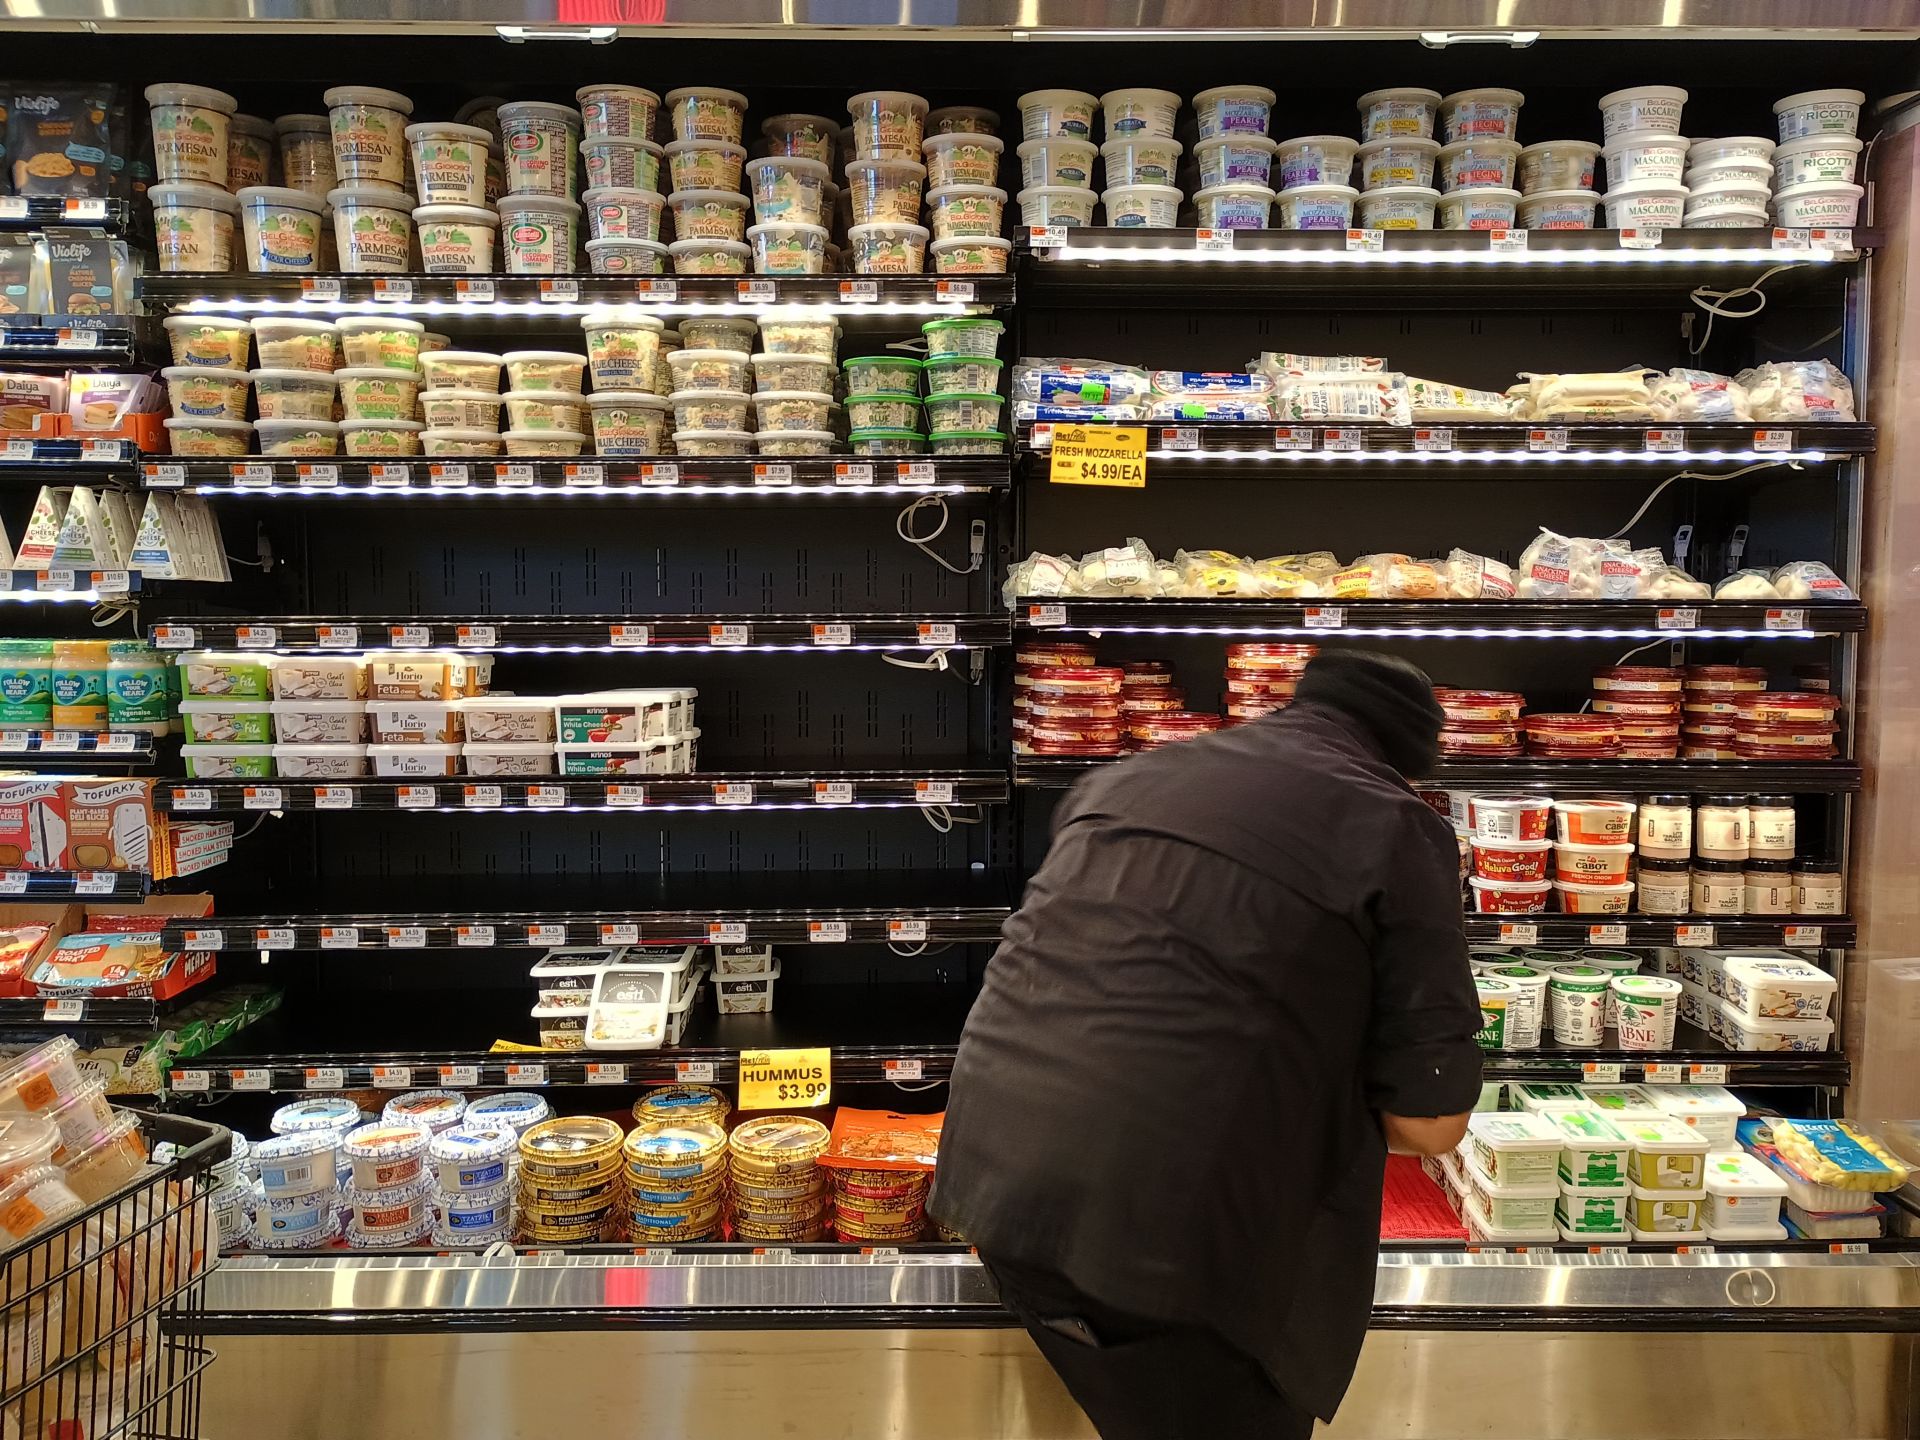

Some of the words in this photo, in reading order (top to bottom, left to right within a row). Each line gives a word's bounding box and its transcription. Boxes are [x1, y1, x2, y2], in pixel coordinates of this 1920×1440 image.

[1806, 110, 1855, 120] RICOTTA
[1230, 116, 1260, 127] PEARLS
[865, 134, 911, 145] PARMESAN
[157, 143, 217, 158] PARMESAN
[336, 142, 392, 156] PARMESAN
[1804, 157, 1853, 167] RICOTTA
[1236, 166, 1264, 176] PEARLS
[420, 172, 475, 186] PARMESAN
[677, 176, 714, 186] PARMESAN
[1227, 216, 1257, 224] PEARLS
[1309, 216, 1338, 225] PEARLS
[689, 226, 735, 236] PARMESAN
[52, 244, 91, 262] Violife
[350, 241, 409, 256] PARMESAN
[424, 254, 476, 266] PARMESAN
[864, 264, 908, 273] PARMESAN
[391, 282, 405, 290] $7.99
[654, 283, 671, 291] $6.99
[607, 359, 642, 368] CHEESE
[7, 379, 39, 392] Daiya
[92, 378, 121, 389] Daiya
[357, 402, 399, 412] ROMANO
[869, 414, 890, 423] BLUE
[615, 438, 649, 447] CHEESE
[1055, 446, 1084, 457] FRESH
[1086, 448, 1143, 460] MOZZARELLA
[249, 467, 264, 475] $4.99
[1081, 462, 1142, 480] $4.99/EA
[1539, 572, 1564, 581] CHEESE
[407, 628, 421, 636] $4.29
[624, 627, 640, 635] $6.99
[829, 626, 843, 634] $6.99
[396, 672, 423, 681] Horio
[3, 679, 30, 687] FOLLOW
[56, 680, 80, 688] FOLLOW
[119, 679, 150, 687] FOLLOW
[377, 684, 399, 694] Feta
[400, 719, 426, 728] Horio
[382, 732, 403, 741] Feta
[400, 763, 426, 771] Horio
[0, 783, 49, 798] TOFURKY
[82, 783, 136, 800] TOFURKY
[414, 788, 429, 796] $4.29
[480, 787, 495, 796] $4.29
[544, 787, 559, 796] $4.79
[182, 832, 203, 844] SMOKED
[205, 830, 216, 839] HAM
[217, 825, 233, 836] STYLE
[178, 846, 201, 859] SMOKED
[203, 844, 215, 853] HAM
[216, 840, 231, 850] STYLE
[180, 862, 198, 874] SMOKED
[200, 858, 210, 868] HAM
[212, 853, 227, 864] STYLE
[1484, 862, 1511, 872] Heluva
[1512, 862, 1538, 873] Good!
[337, 929, 351, 937] $4.29
[544, 926, 558, 934] $4.29
[1606, 926, 1620, 934] $2.99
[1692, 926, 1707, 934] $7.99
[1801, 926, 1815, 934] $7.99
[57, 947, 101, 956] ROASTED
[736, 946, 752, 954] esti
[53, 953, 86, 963] TURKY
[110, 966, 125, 977] 14g
[559, 979, 577, 988] esti
[44, 988, 85, 997] TOFURKY
[127, 987, 153, 997] MEATY
[616, 990, 643, 1001] esti
[559, 1020, 577, 1028] esti
[1472, 1031, 1498, 1040] ABNE
[1621, 1028, 1656, 1042] ABNE
[321, 1069, 335, 1077] $4.29
[522, 1066, 537, 1074] $4.29
[743, 1067, 822, 1082] HUMMUS
[778, 1083, 827, 1101] $3.99
[640, 1192, 681, 1200] TRADITIONAL
[461, 1212, 491, 1221] TZATZIKI
[558, 1213, 596, 1223] PEPPERHOUSE
[635, 1217, 672, 1225] TRADITIONAL
